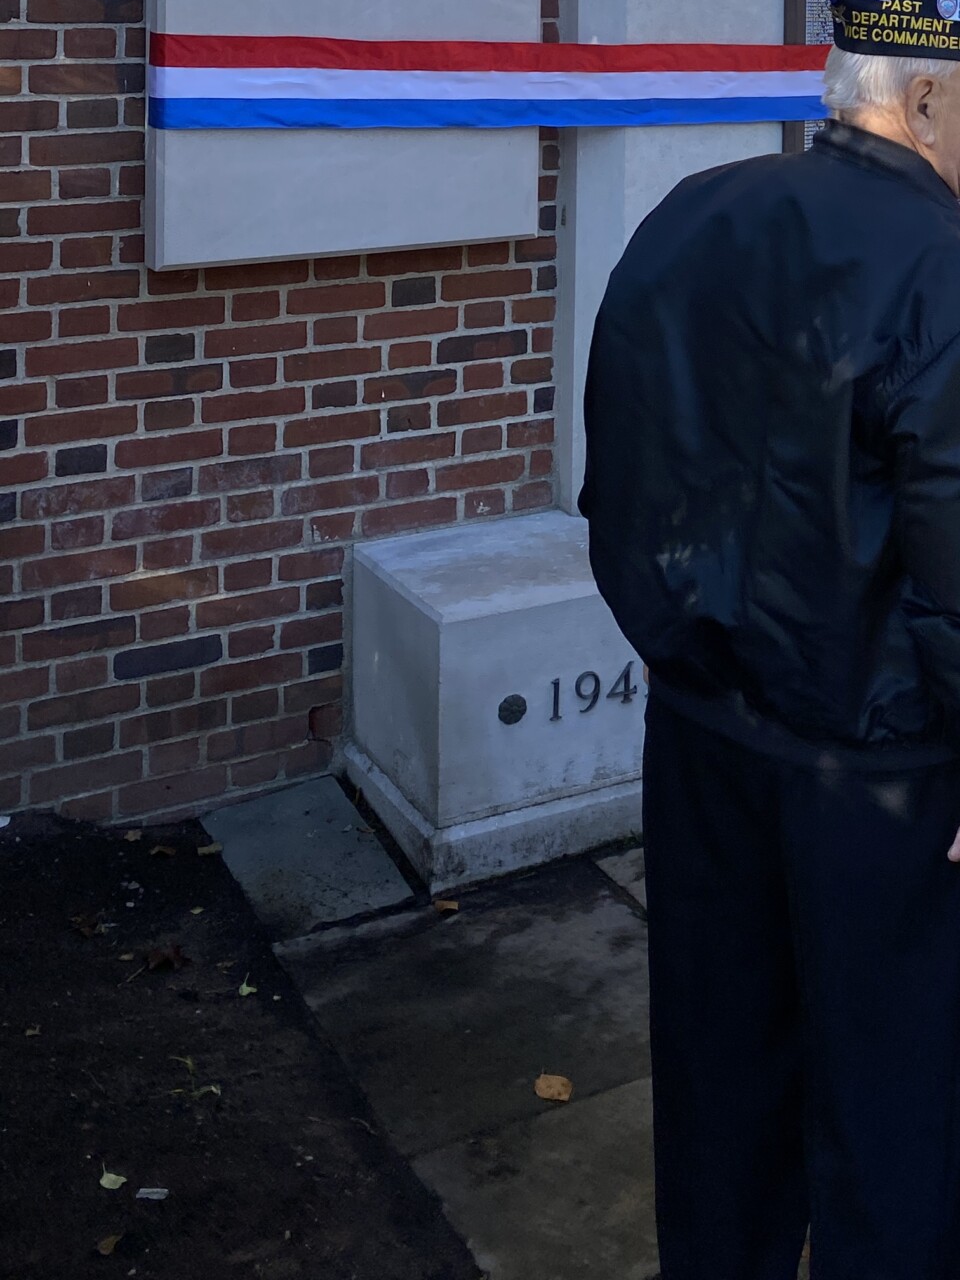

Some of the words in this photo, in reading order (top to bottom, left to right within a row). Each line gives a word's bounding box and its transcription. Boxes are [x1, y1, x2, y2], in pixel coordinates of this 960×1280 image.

[882, 0, 923, 14] PAST
[852, 11, 954, 34] DEPARTMENT
[844, 25, 868, 40] VICE
[549, 660, 649, 722] 194
